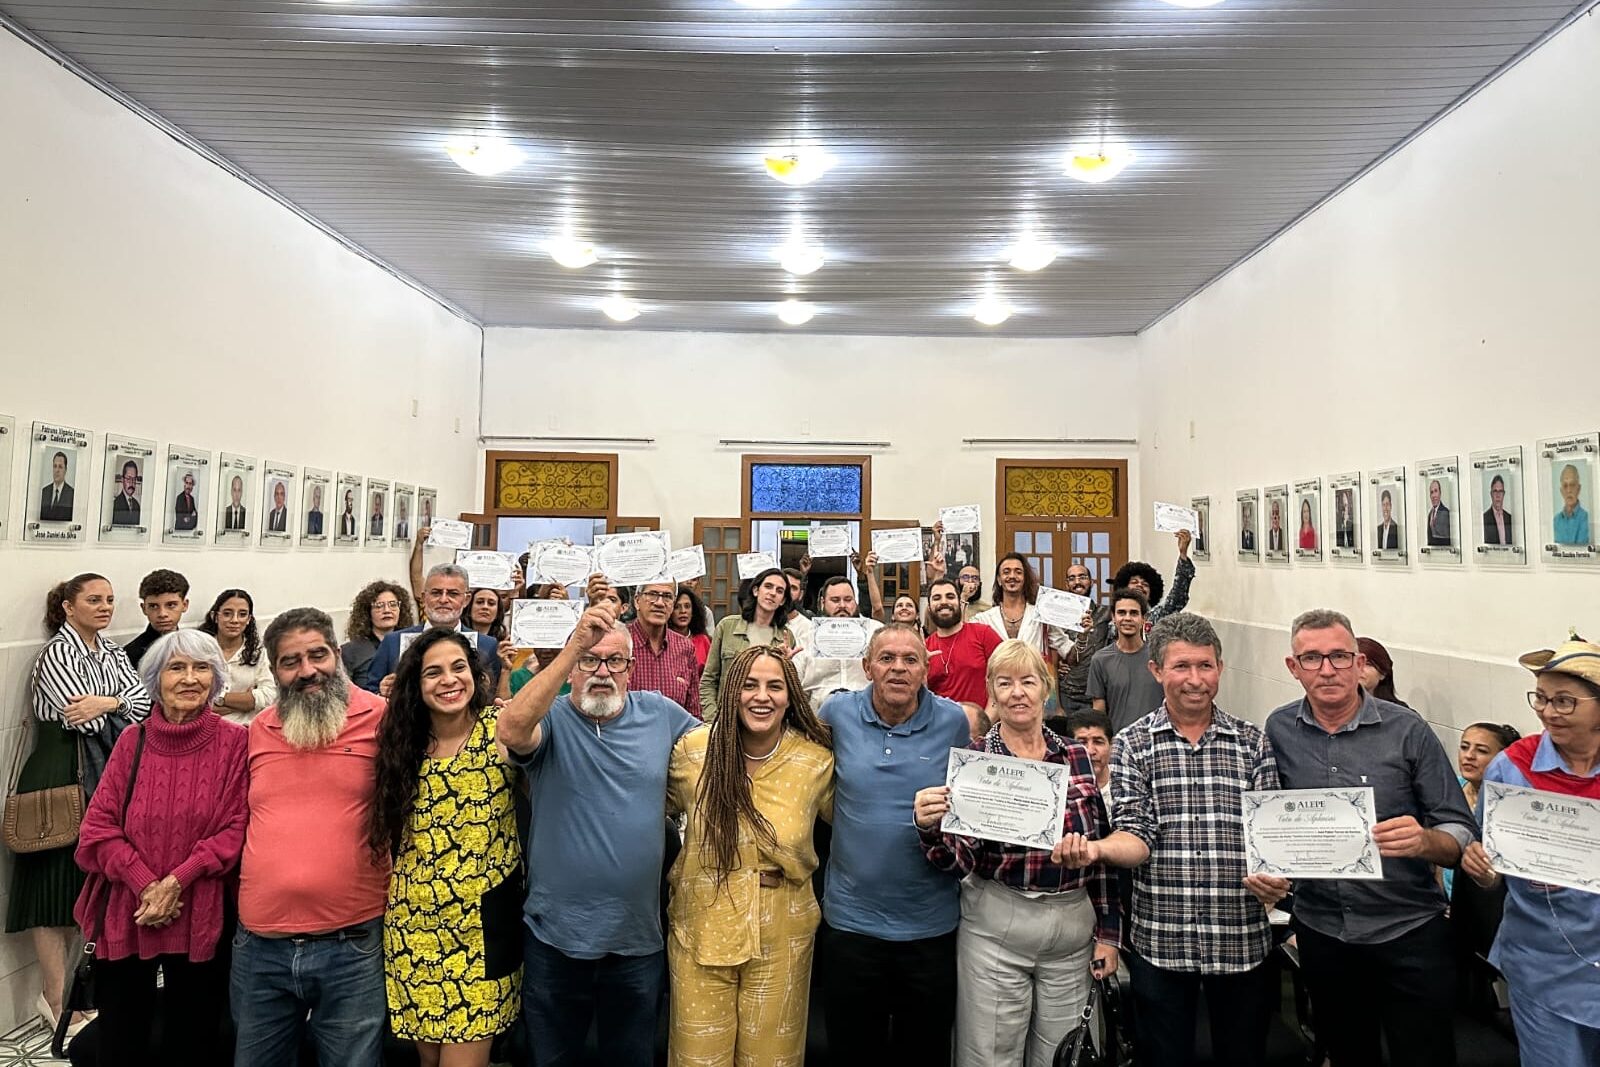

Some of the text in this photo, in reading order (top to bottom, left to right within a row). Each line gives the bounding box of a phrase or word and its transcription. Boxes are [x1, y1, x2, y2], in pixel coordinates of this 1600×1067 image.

[998, 766, 1025, 777] ALEPE
[1297, 800, 1326, 808] ALEPE
[1546, 803, 1579, 815] ALEPE
